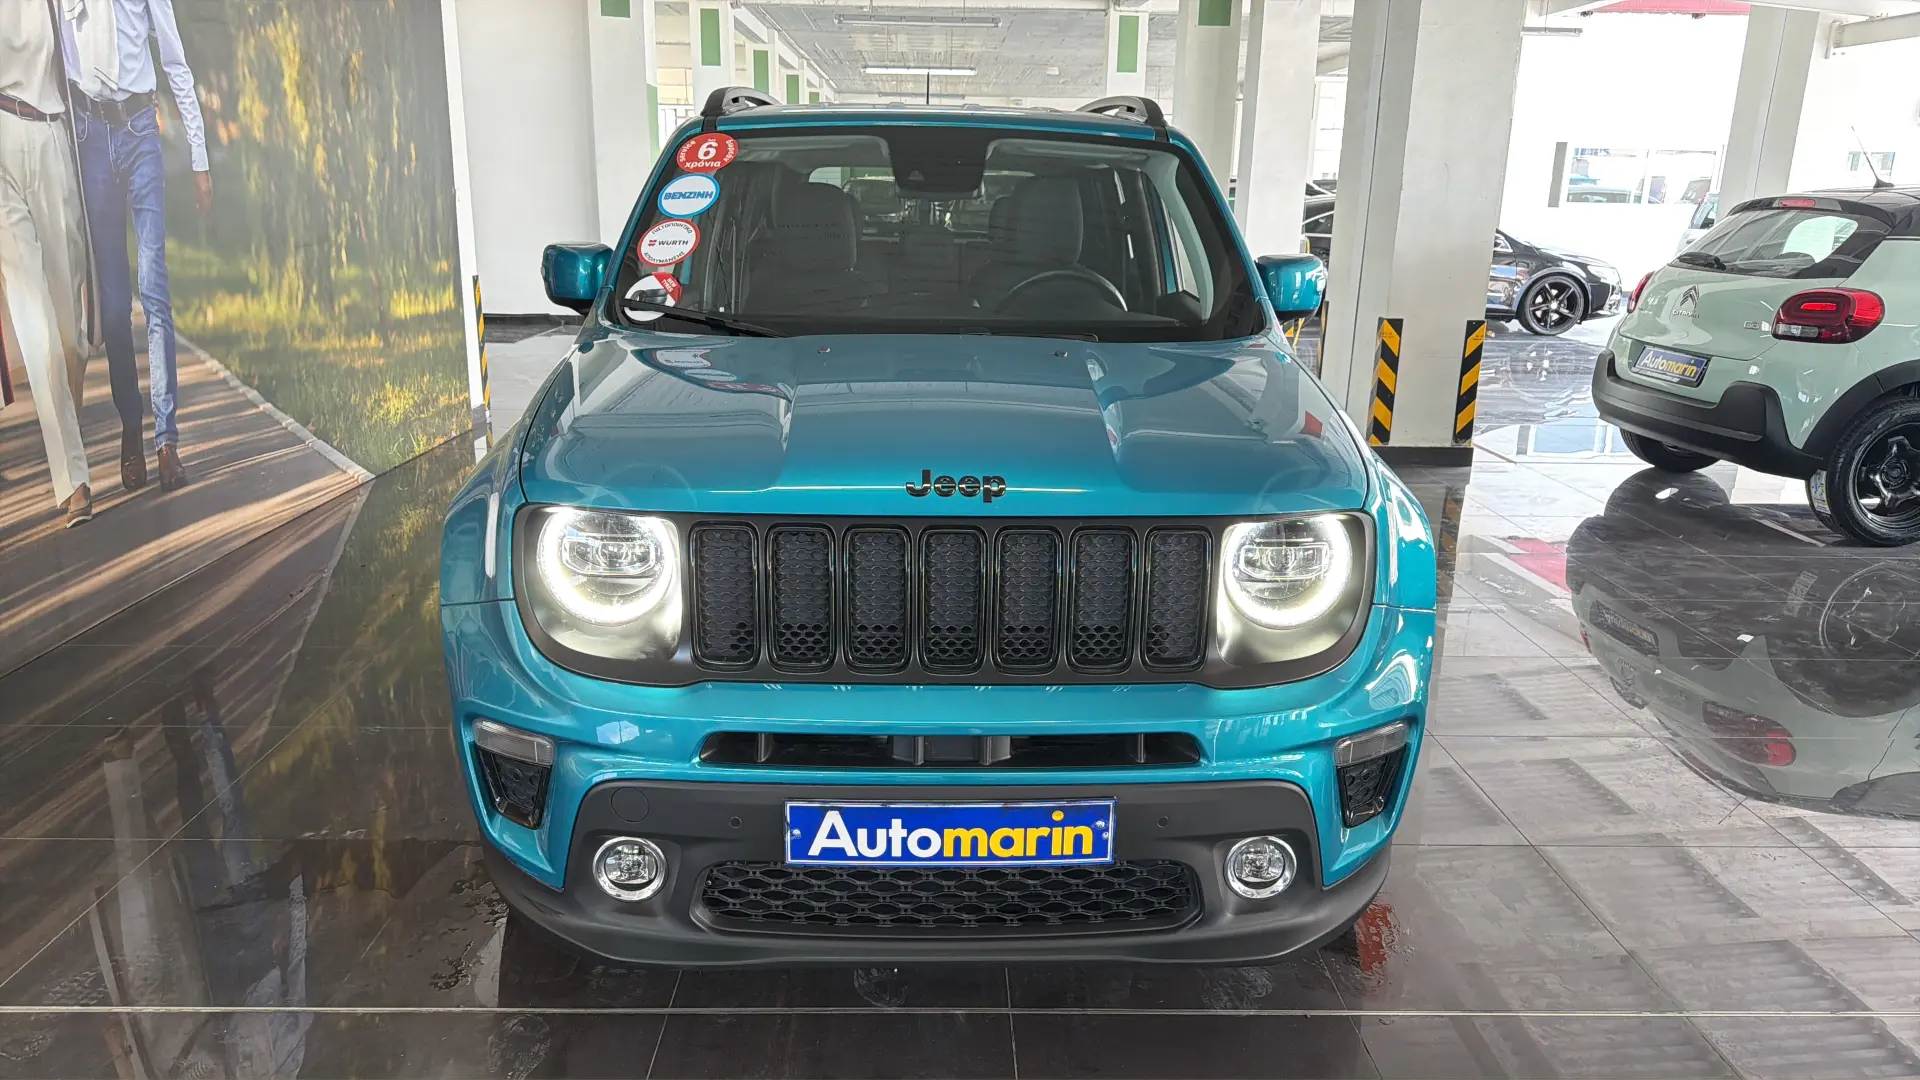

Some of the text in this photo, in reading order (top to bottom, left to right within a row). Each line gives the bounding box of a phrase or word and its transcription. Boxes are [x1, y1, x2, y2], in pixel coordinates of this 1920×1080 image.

[697, 141, 719, 160] 6
[684, 160, 721, 169] χρόνια
[1640, 351, 1697, 377] Automarin
[905, 469, 1006, 503] Jeep
[807, 809, 1093, 858] Automarin
